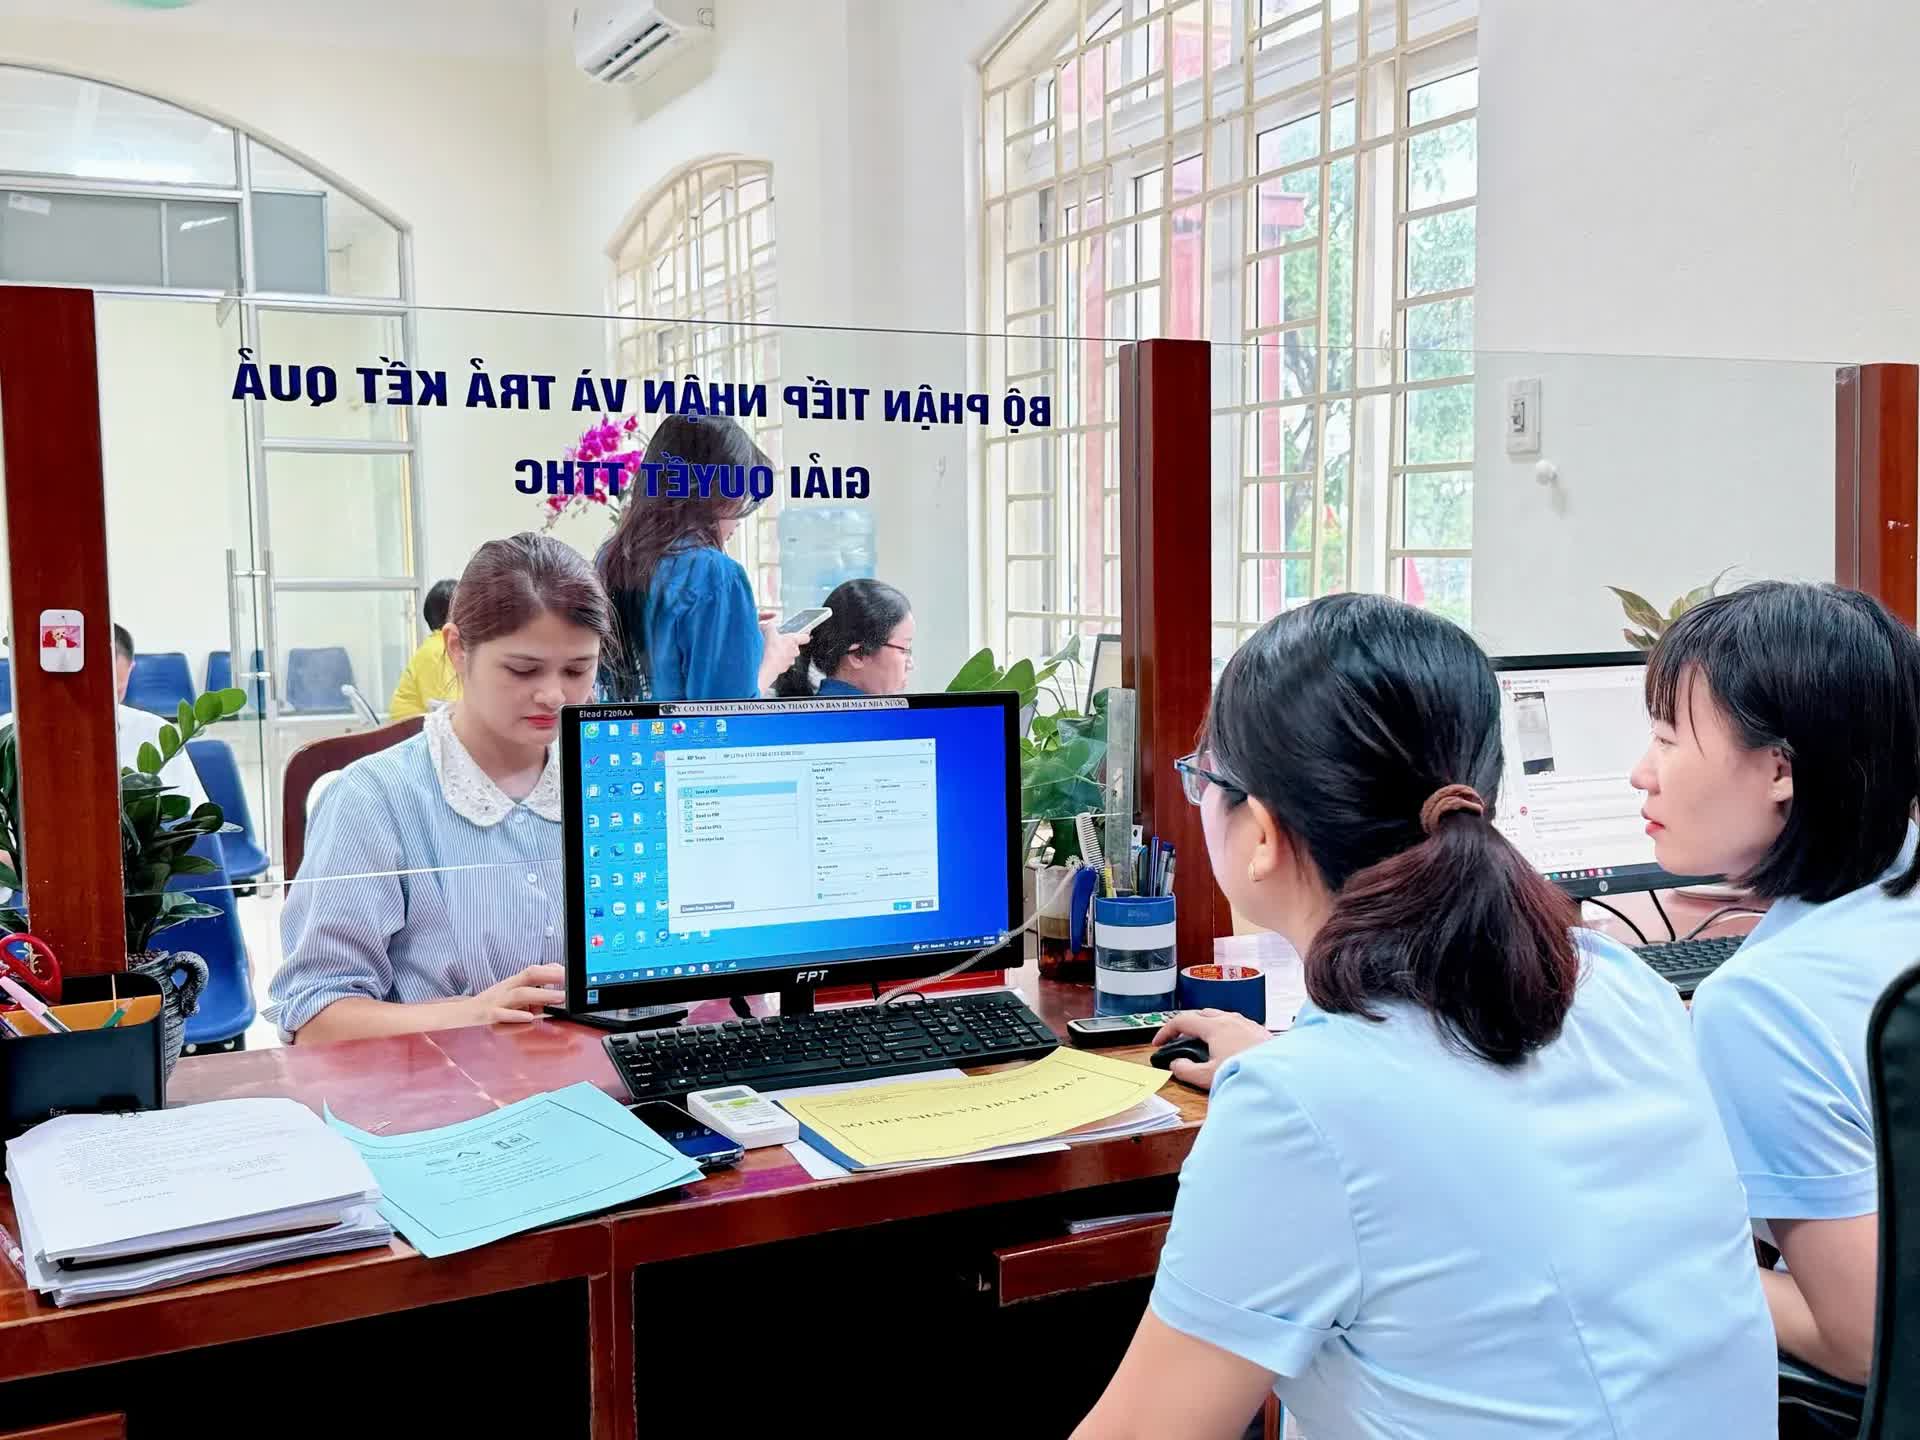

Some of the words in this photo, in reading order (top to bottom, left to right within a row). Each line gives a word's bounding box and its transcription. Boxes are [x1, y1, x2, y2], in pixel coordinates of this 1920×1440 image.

[579, 710, 601, 718] Elead
[603, 709, 634, 717] F20RAA
[796, 969, 829, 984] FPT
